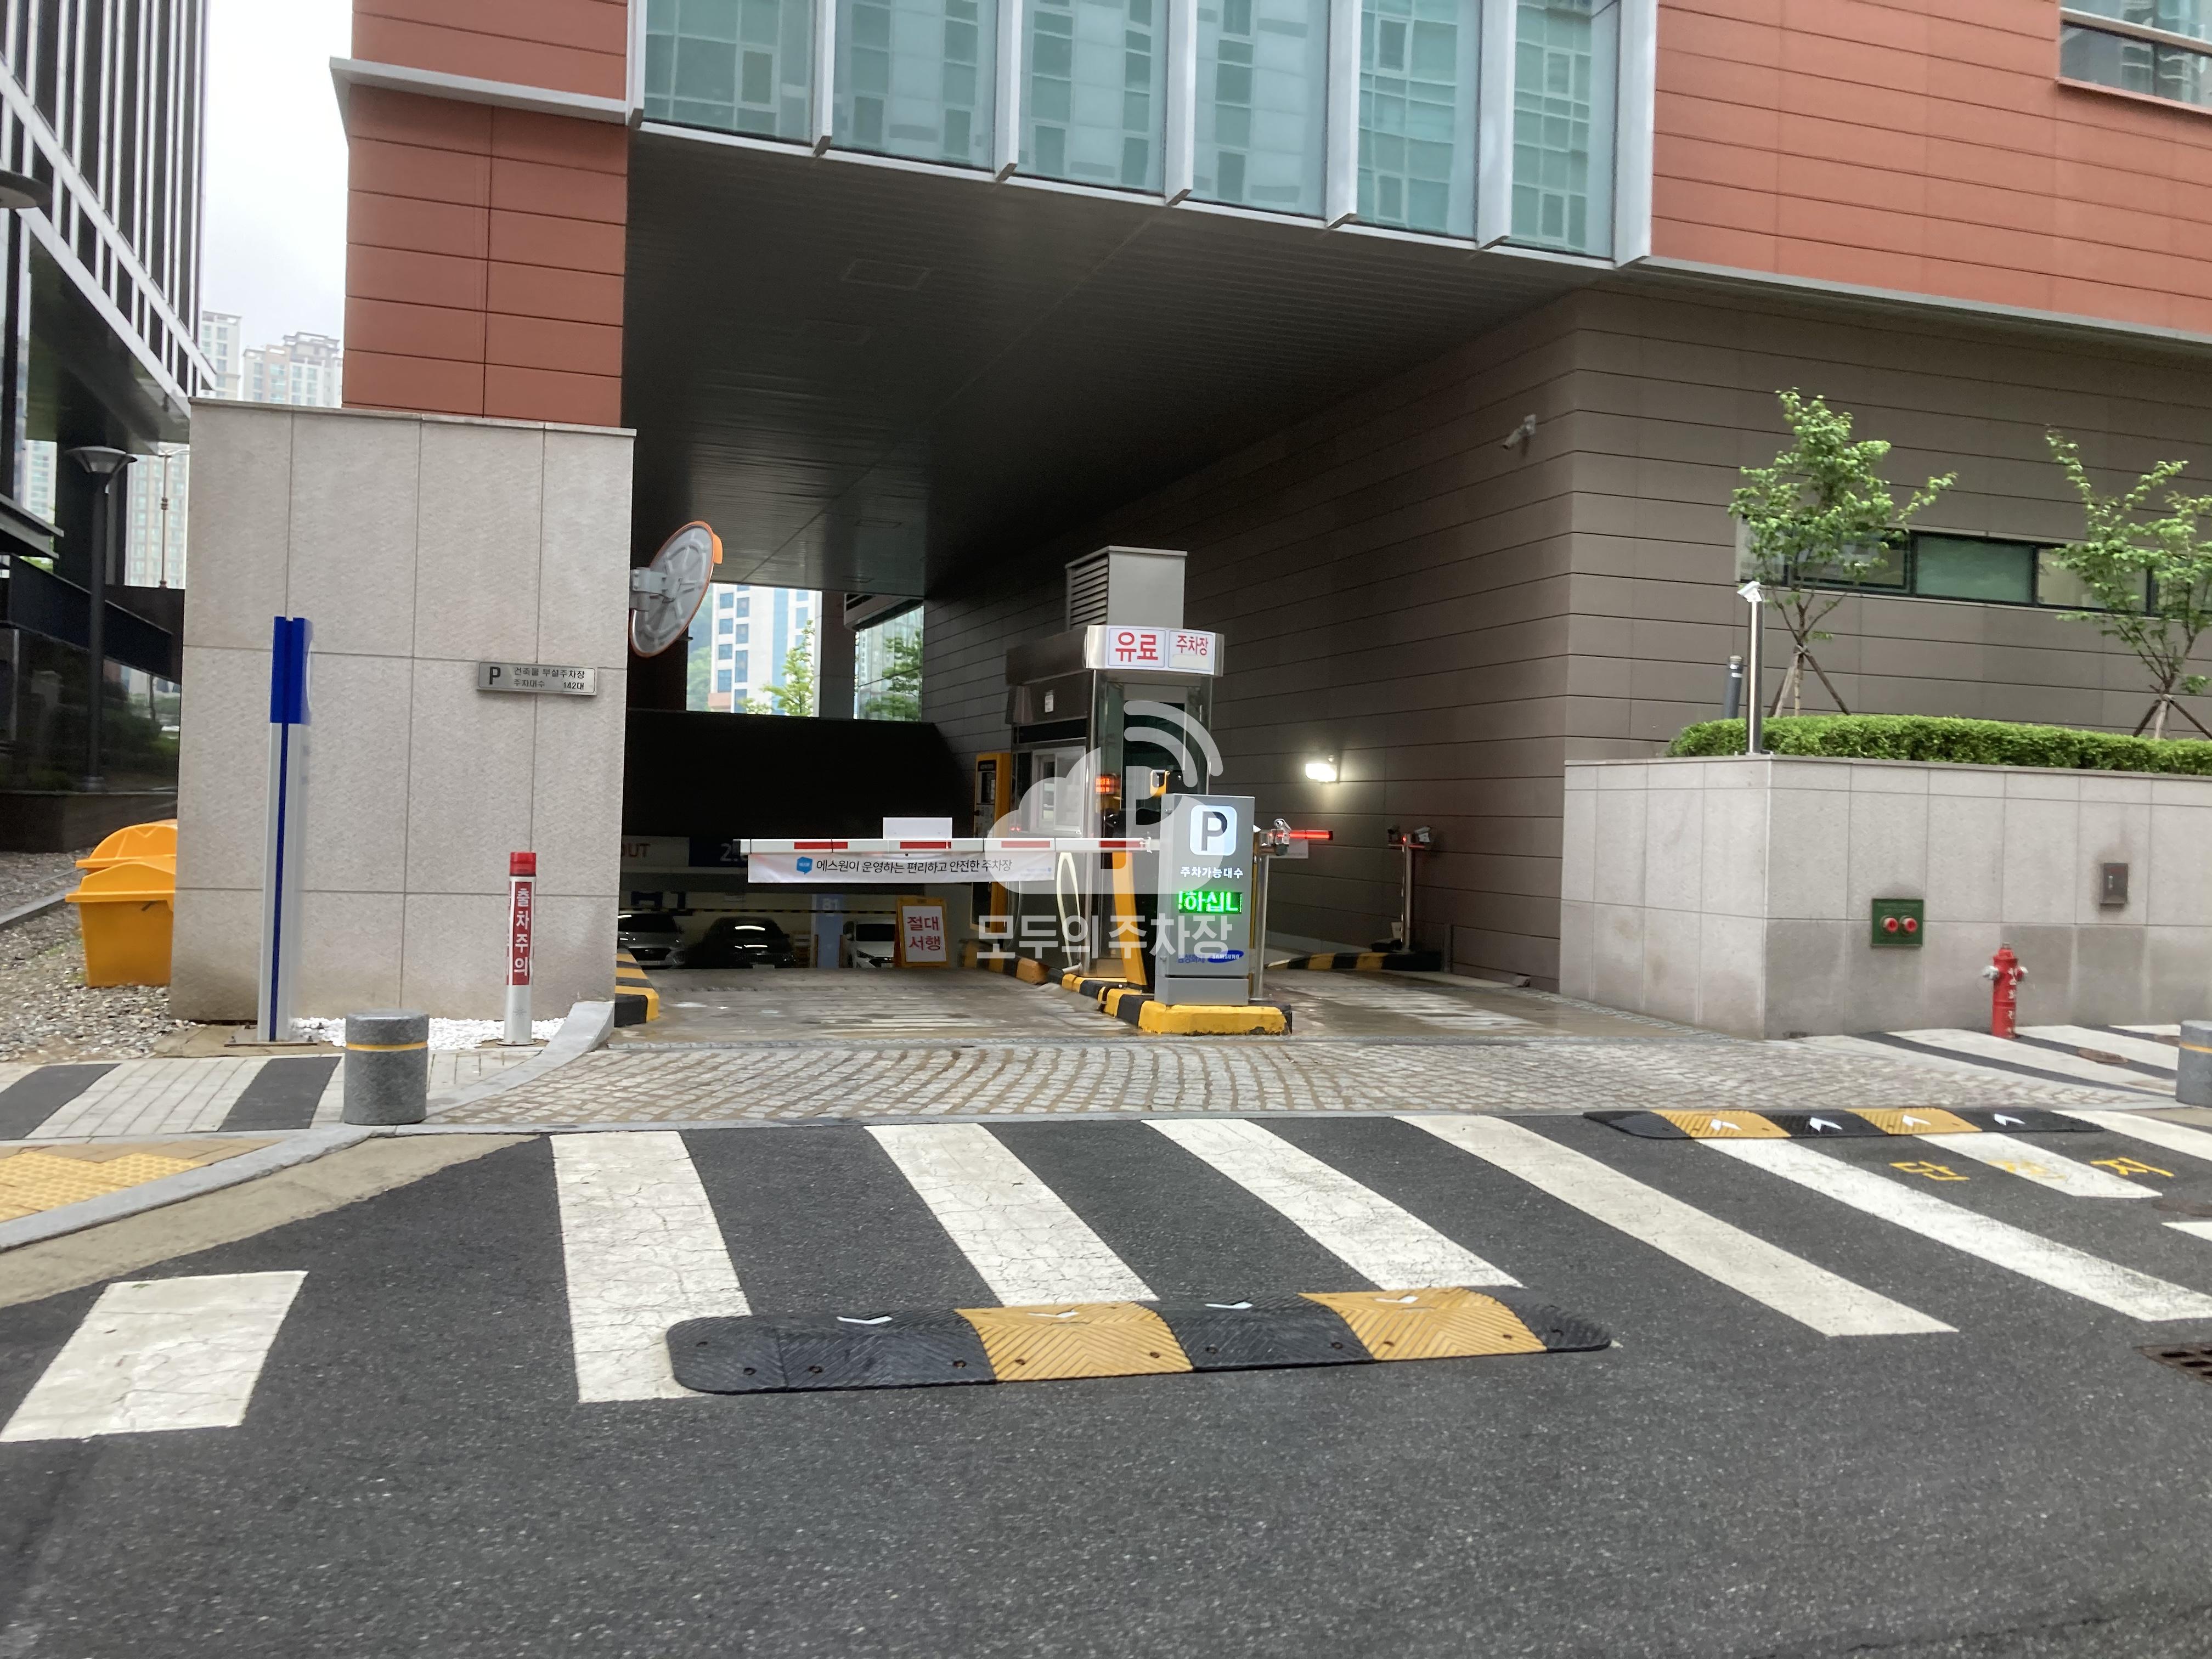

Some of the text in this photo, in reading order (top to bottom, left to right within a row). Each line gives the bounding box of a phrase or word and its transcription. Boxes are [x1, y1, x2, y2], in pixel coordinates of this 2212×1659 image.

[1115, 632, 1158, 662] 유료
[1176, 635, 1208, 656] 주차장
[489, 667, 500, 685] P
[514, 667, 539, 676] 건축물
[514, 679, 584, 690] 주차대수 142대
[1201, 811, 1227, 851] P
[817, 860, 859, 872] 에스원이
[862, 861, 904, 873] 운영하는
[907, 861, 946, 873] 편리하고
[950, 860, 980, 872] 안전한
[982, 860, 1013, 872] 주차장
[1180, 866, 1243, 879] 주차가능대수
[514, 888, 530, 976] 출차주의
[907, 916, 939, 932] 절대
[909, 936, 940, 951] 서행
